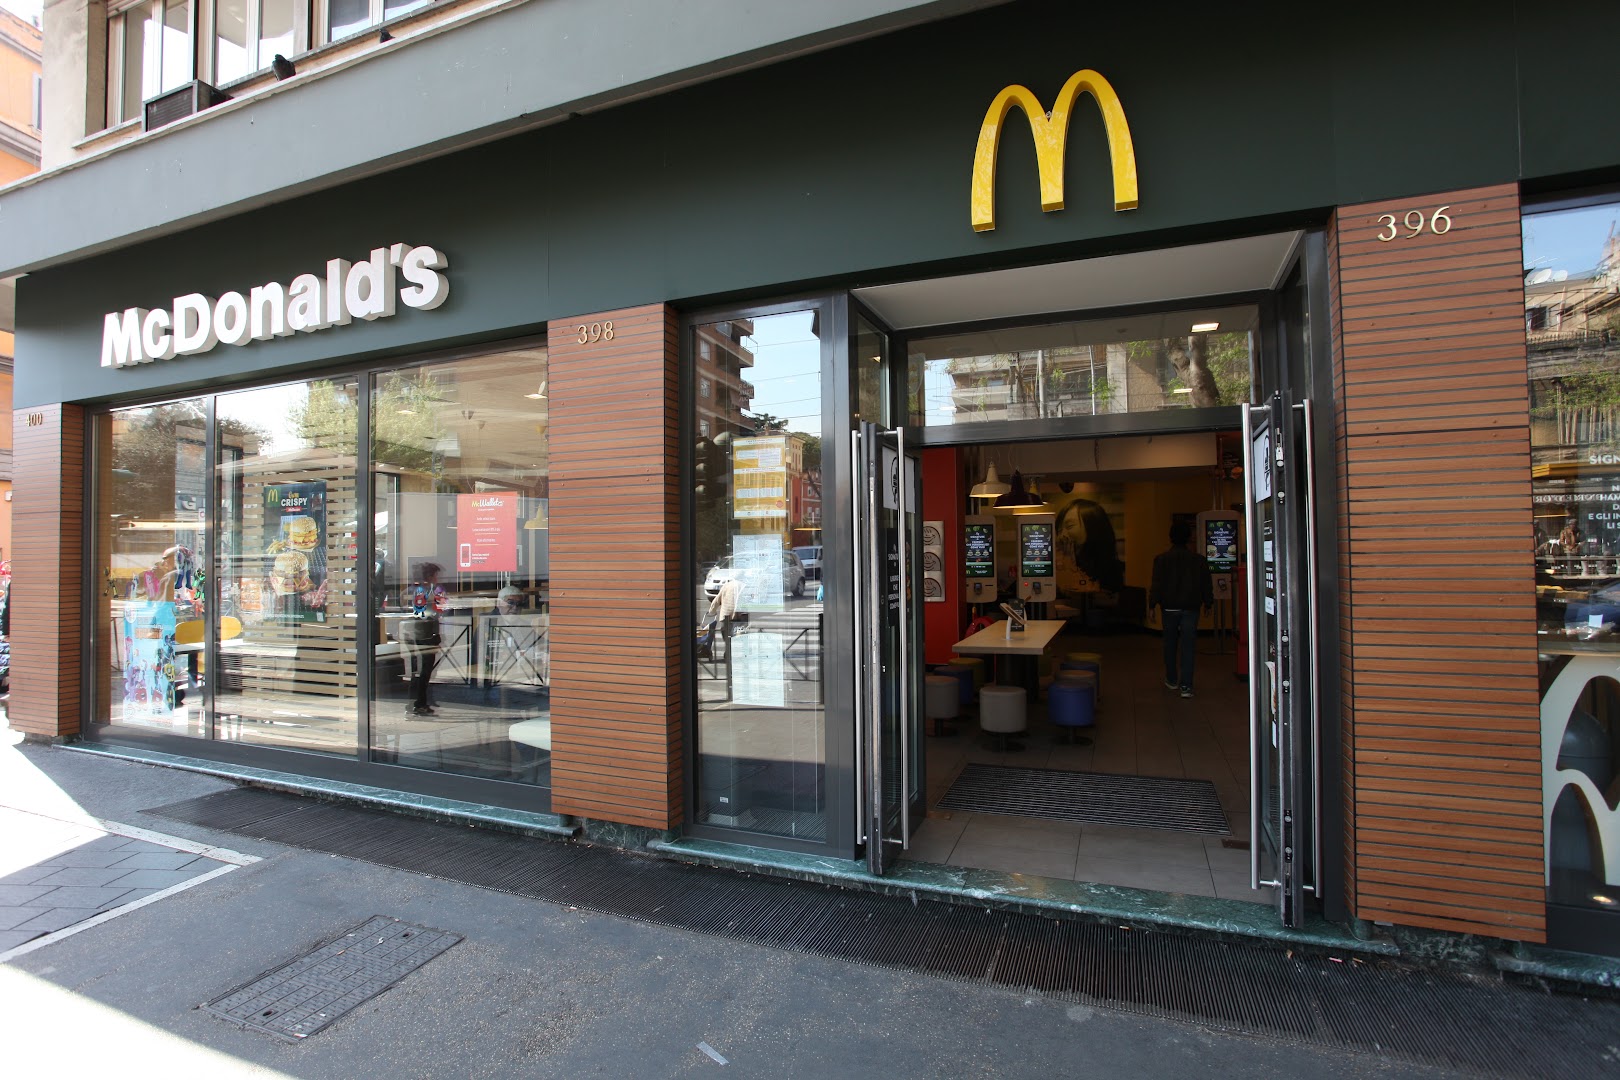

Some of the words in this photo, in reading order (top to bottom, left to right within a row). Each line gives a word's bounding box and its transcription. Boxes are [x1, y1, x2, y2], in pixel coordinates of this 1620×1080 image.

[1377, 206, 1452, 242] 396
[101, 243, 449, 369] McDonald's
[577, 320, 614, 345] 398
[25, 412, 43, 427] 400
[280, 497, 308, 507] CRISPY
